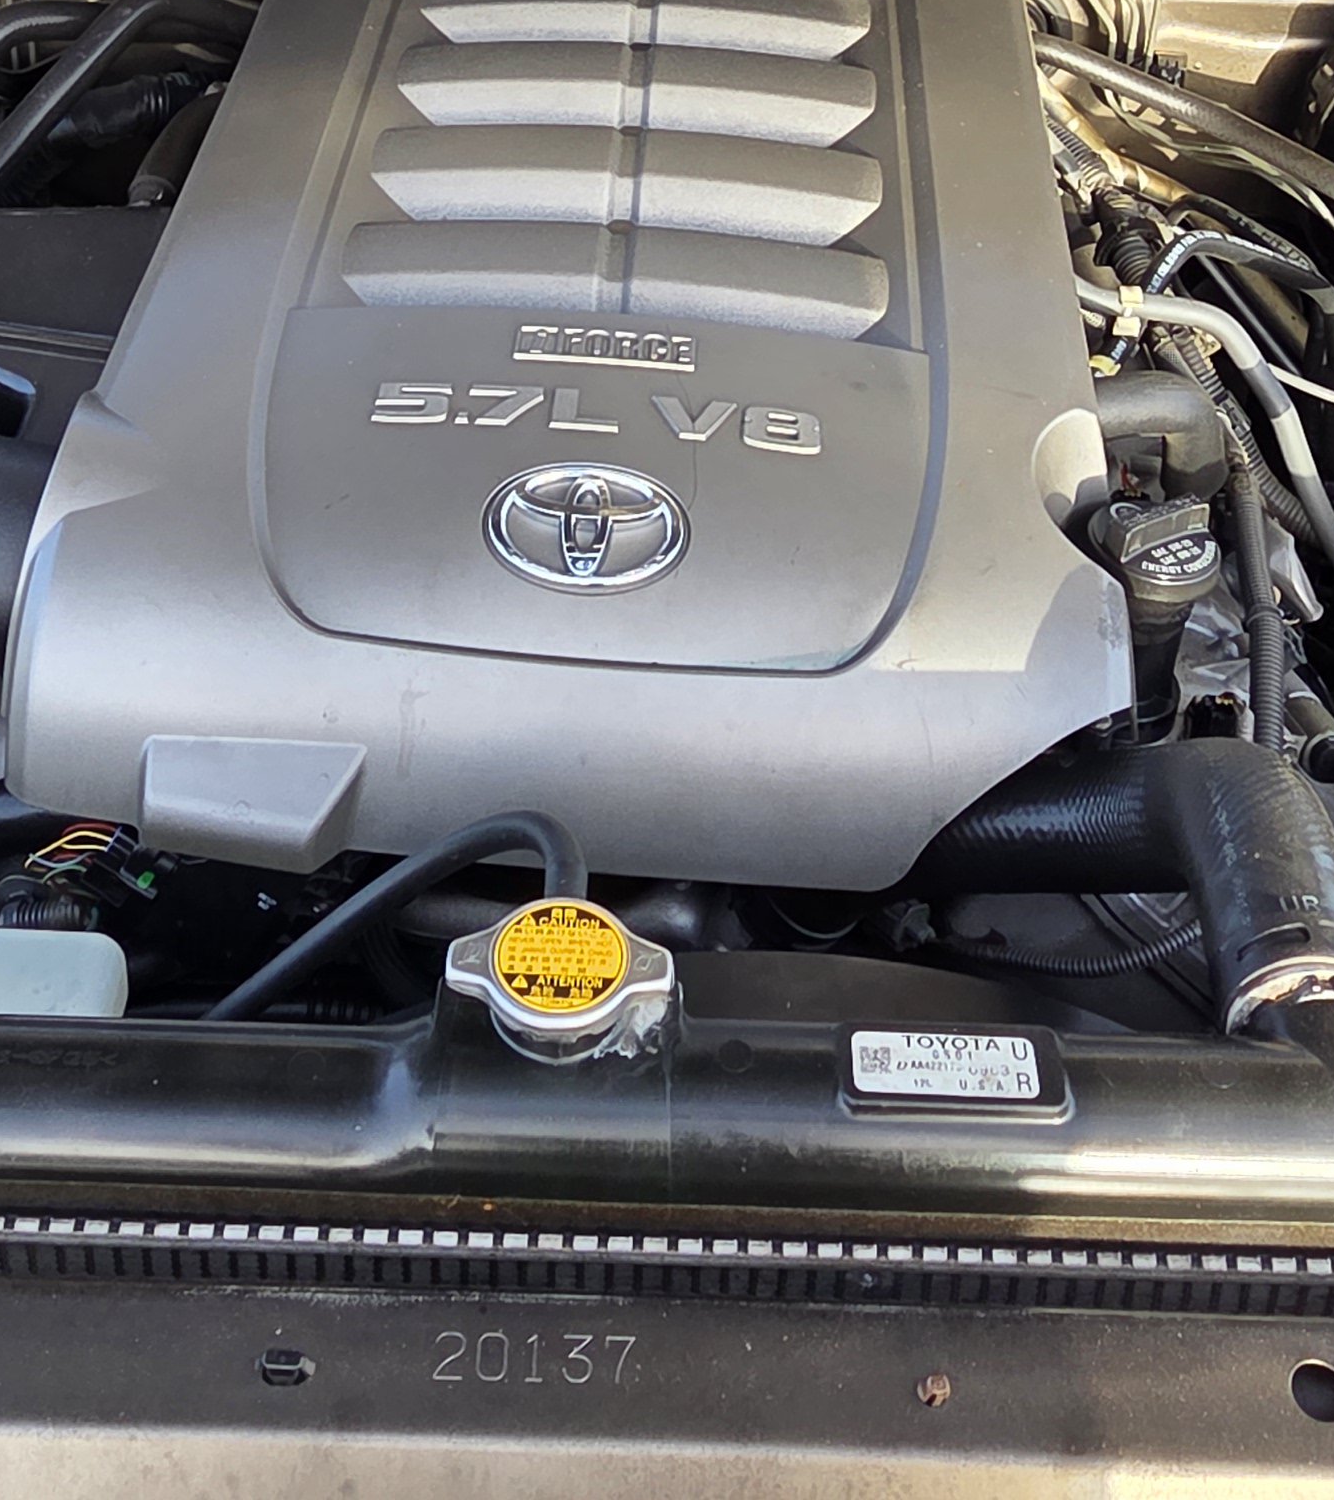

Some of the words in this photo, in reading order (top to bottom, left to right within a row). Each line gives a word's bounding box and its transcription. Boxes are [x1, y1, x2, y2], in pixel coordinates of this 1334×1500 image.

[370, 382, 620, 434] 5.7L
[652, 395, 822, 456] V8
[1141, 560, 1183, 574] ENERGY
[539, 917, 601, 930] CAUTION
[541, 938, 563, 946] OPEN
[536, 975, 604, 989] ATTENTION
[902, 1034, 1001, 1052] TOYOTA
[1011, 1041, 1030, 1062] U
[1015, 1071, 1034, 1094] R
[431, 1330, 638, 1385] 20137
